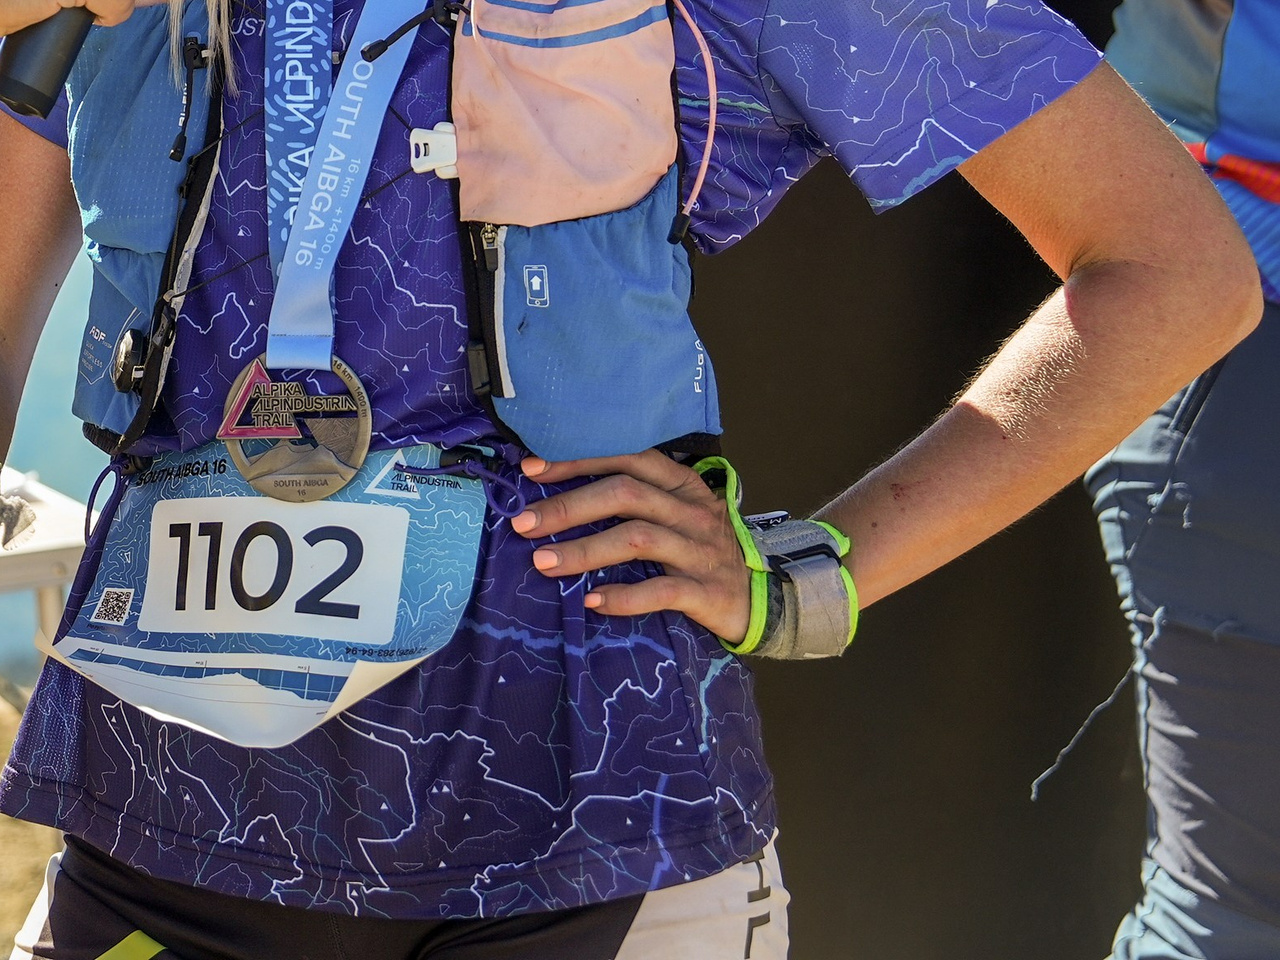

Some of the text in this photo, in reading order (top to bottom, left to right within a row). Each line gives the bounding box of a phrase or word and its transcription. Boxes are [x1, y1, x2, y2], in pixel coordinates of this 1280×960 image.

[295, 41, 374, 267] OUTH AIBGA 16
[693, 339, 704, 393] FUGA
[252, 382, 305, 398] ALPIKA
[253, 413, 295, 427] TRAIL
[212, 459, 227, 475] 16
[273, 479, 302, 488] SOUTH
[390, 482, 418, 493] TRAIL
[169, 520, 365, 620] 1102
